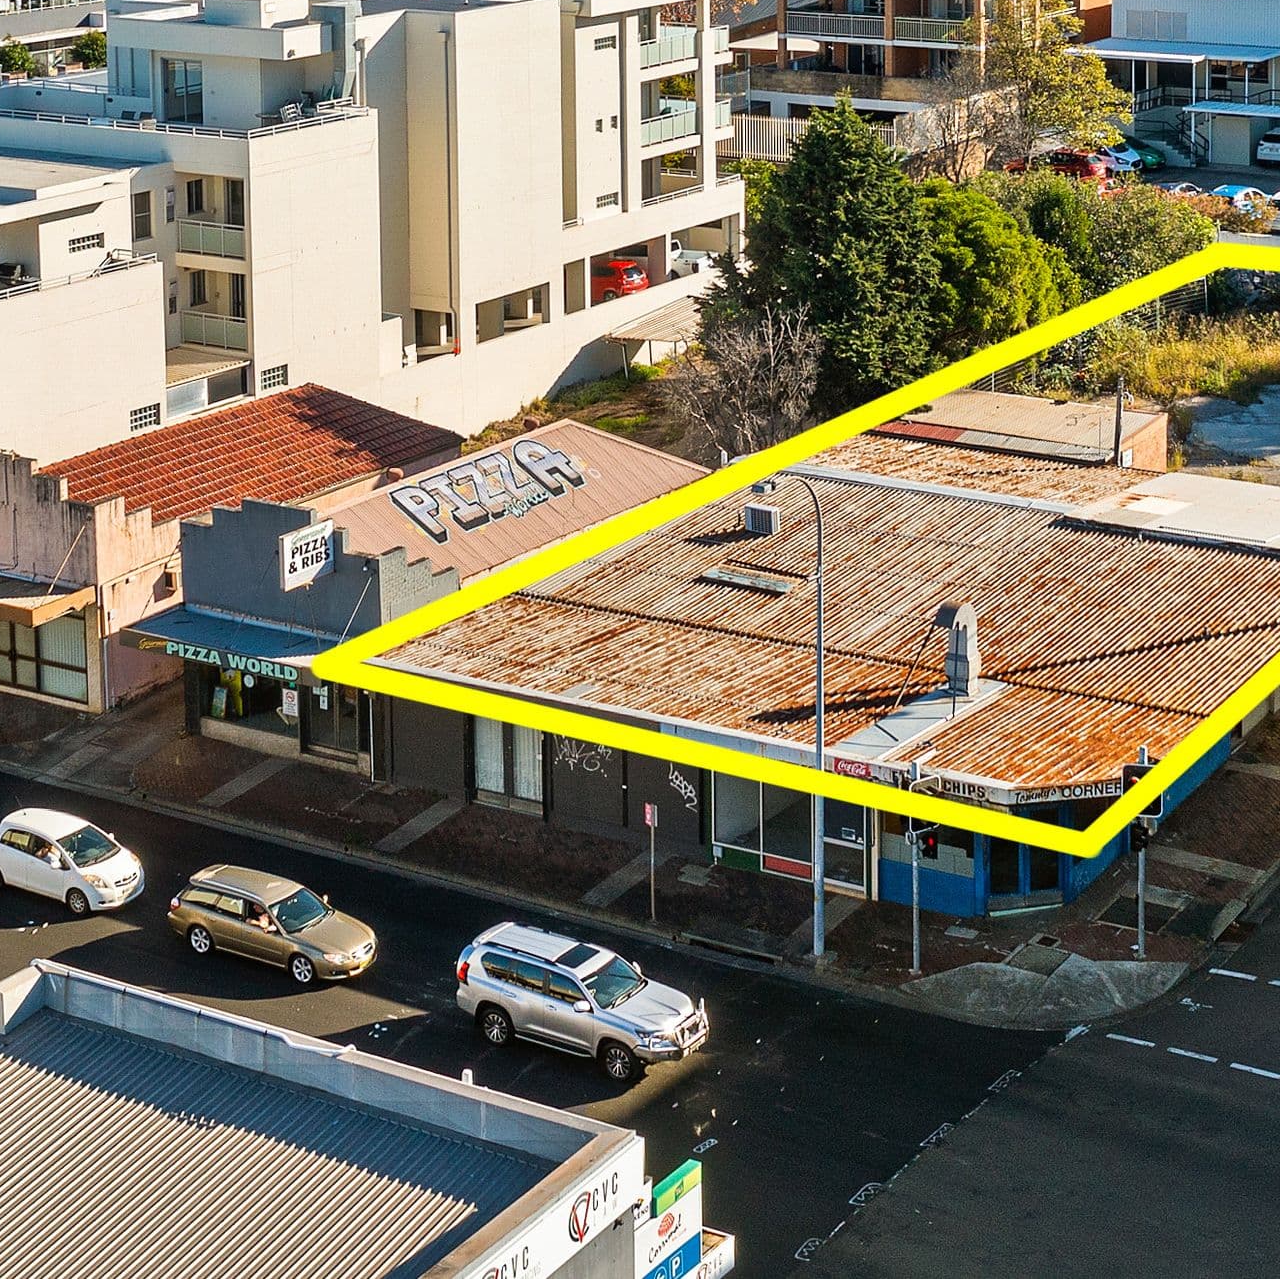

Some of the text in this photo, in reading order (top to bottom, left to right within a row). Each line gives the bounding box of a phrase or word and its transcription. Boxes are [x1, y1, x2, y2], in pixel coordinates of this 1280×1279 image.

[389, 439, 585, 544] PIZZA
[291, 535, 328, 559] PIZZA
[288, 548, 330, 574] & RIBS
[166, 641, 221, 665] PIZZA
[227, 653, 298, 681] WORLD
[943, 780, 986, 799] CHIPS
[671, 1256, 681, 1277] P
